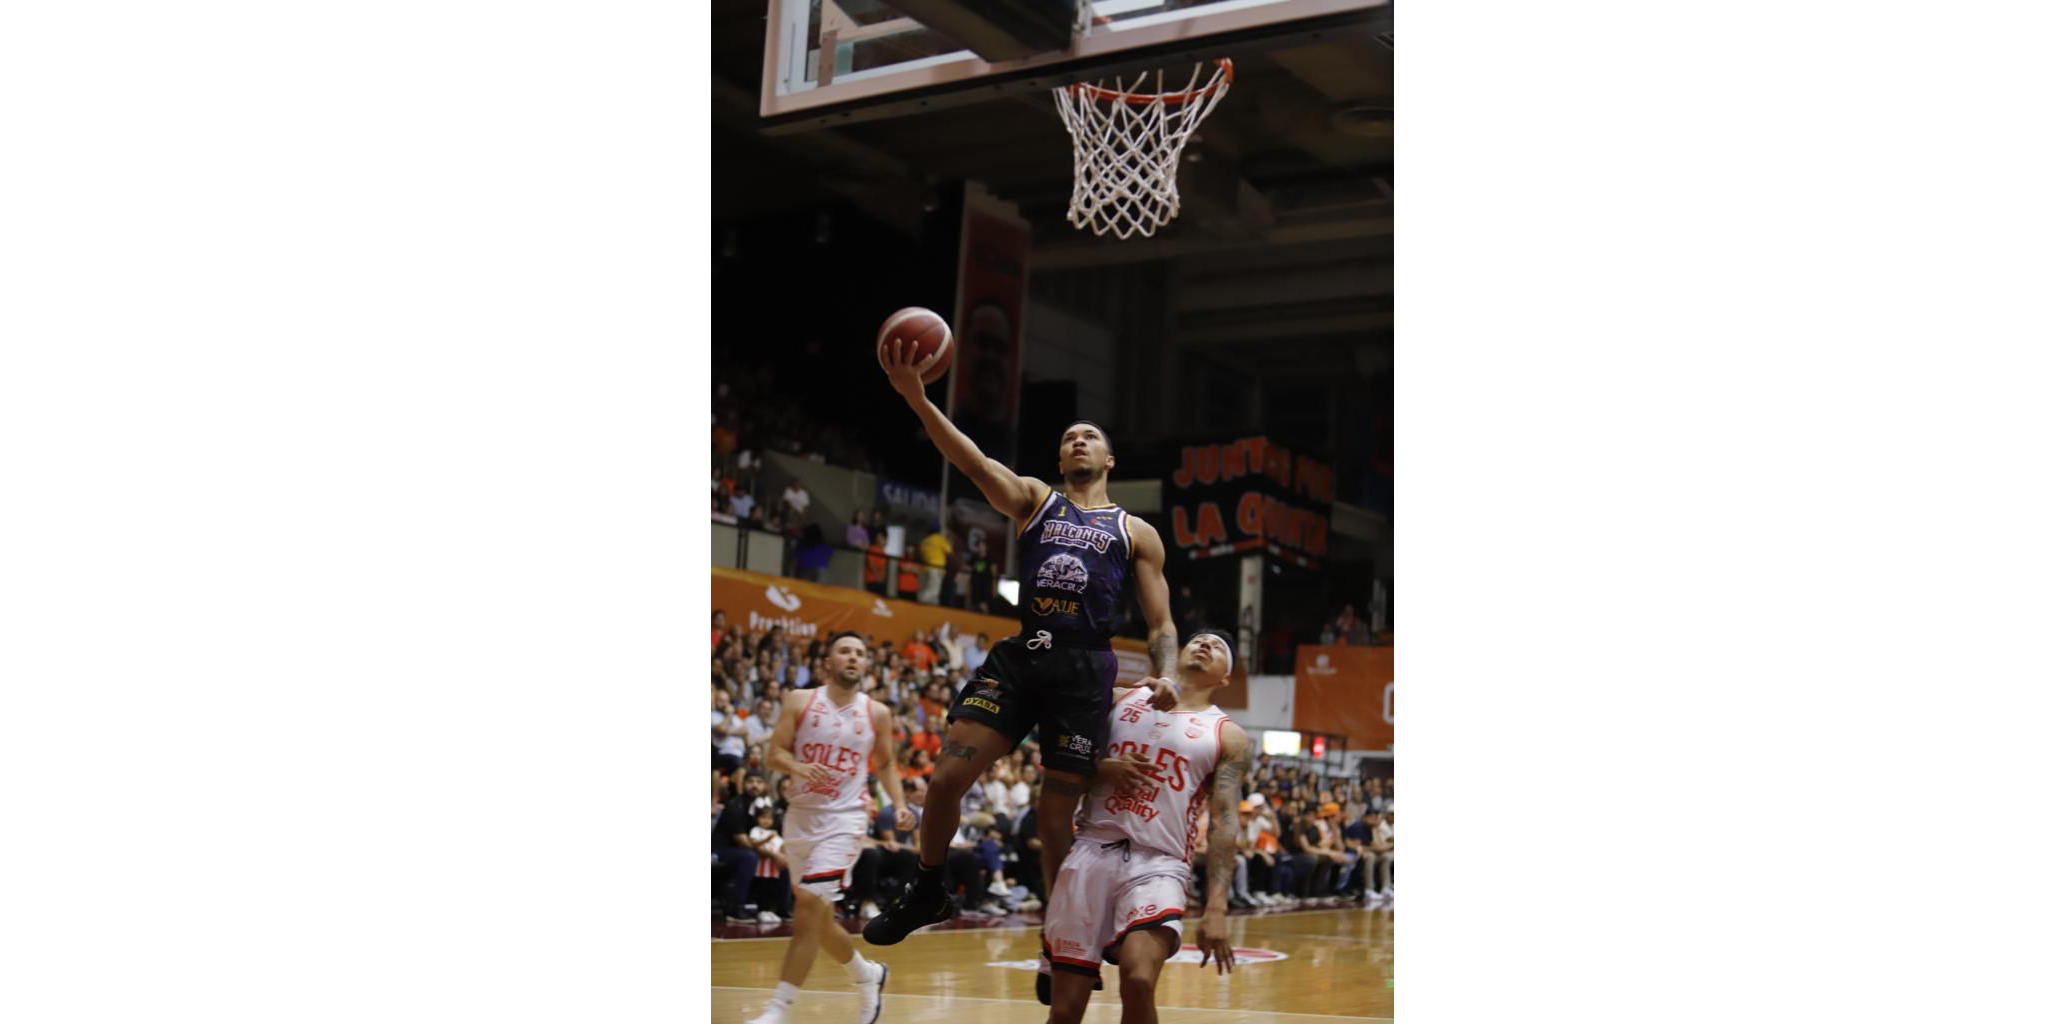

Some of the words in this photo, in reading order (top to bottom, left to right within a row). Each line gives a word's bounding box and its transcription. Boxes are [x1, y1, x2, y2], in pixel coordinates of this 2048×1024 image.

[1172, 501, 1227, 548] LA
[1042, 521, 1113, 552] HALCONES
[1036, 579, 1087, 594] VERACRUZ
[1119, 707, 1143, 723] 25
[1071, 734, 1093, 747] VERA
[1104, 795, 1160, 824] Quality
